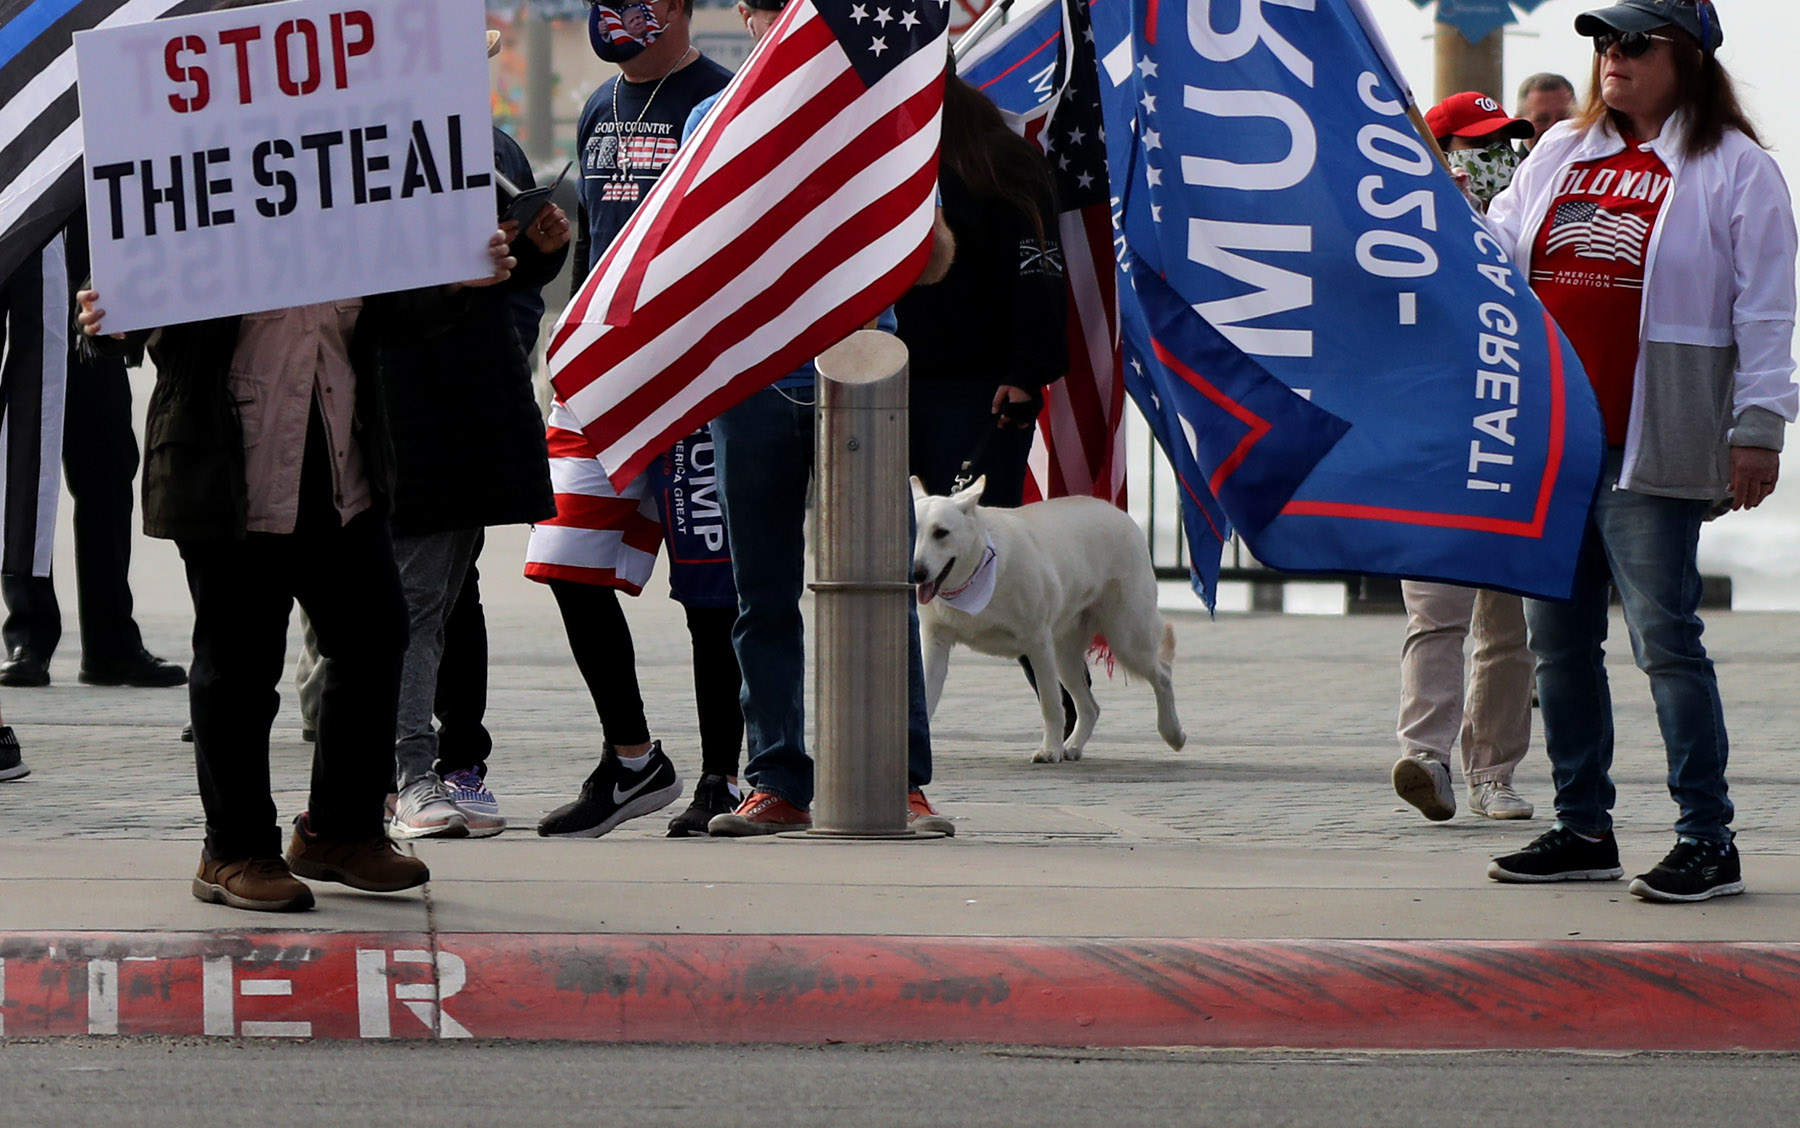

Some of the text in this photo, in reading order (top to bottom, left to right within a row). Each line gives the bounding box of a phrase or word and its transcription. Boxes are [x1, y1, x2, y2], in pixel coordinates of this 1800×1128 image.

[164, 10, 375, 114] STOP
[594, 121, 615, 134] GOD
[624, 121, 674, 134] COUNTRY
[585, 136, 678, 170] TRUMP
[93, 114, 492, 240] THE STEAL
[601, 182, 641, 202] 2020
[1612, 169, 1670, 204] NAV
[1555, 277, 1610, 288] TRADITION
[1557, 270, 1610, 281] AMERICAN
[688, 428, 724, 552] UMP
[673, 487, 687, 535] GREAT
